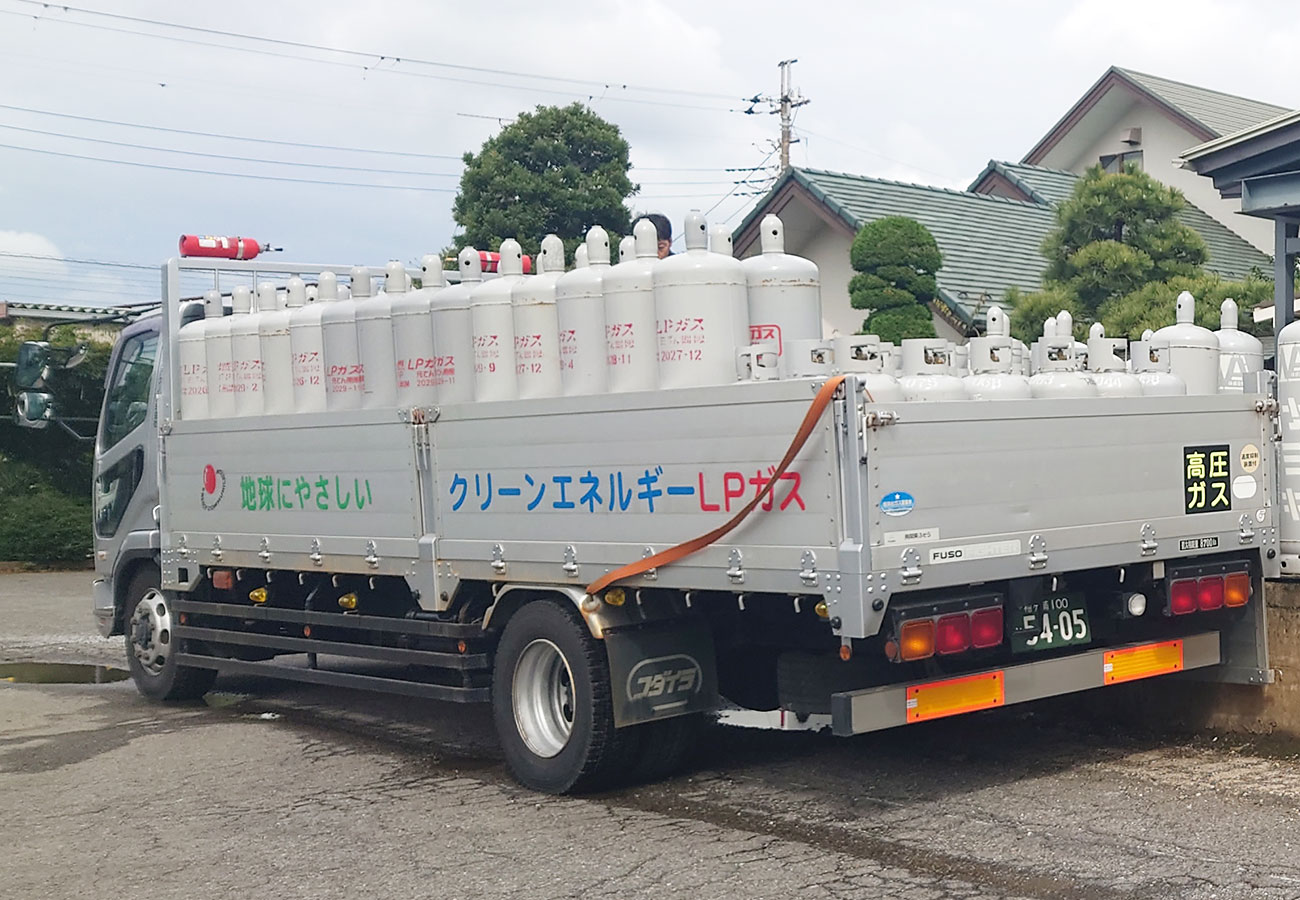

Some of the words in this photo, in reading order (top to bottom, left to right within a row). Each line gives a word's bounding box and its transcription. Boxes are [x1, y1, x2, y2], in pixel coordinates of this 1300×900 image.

[1186, 451, 1228, 479] 高圧
[240, 474, 373, 511] 地球にやさしい
[1187, 481, 1229, 508] ガス
[933, 550, 963, 561] FUSO
[1051, 598, 1069, 609] 100
[1023, 609, 1087, 646] 54-05
